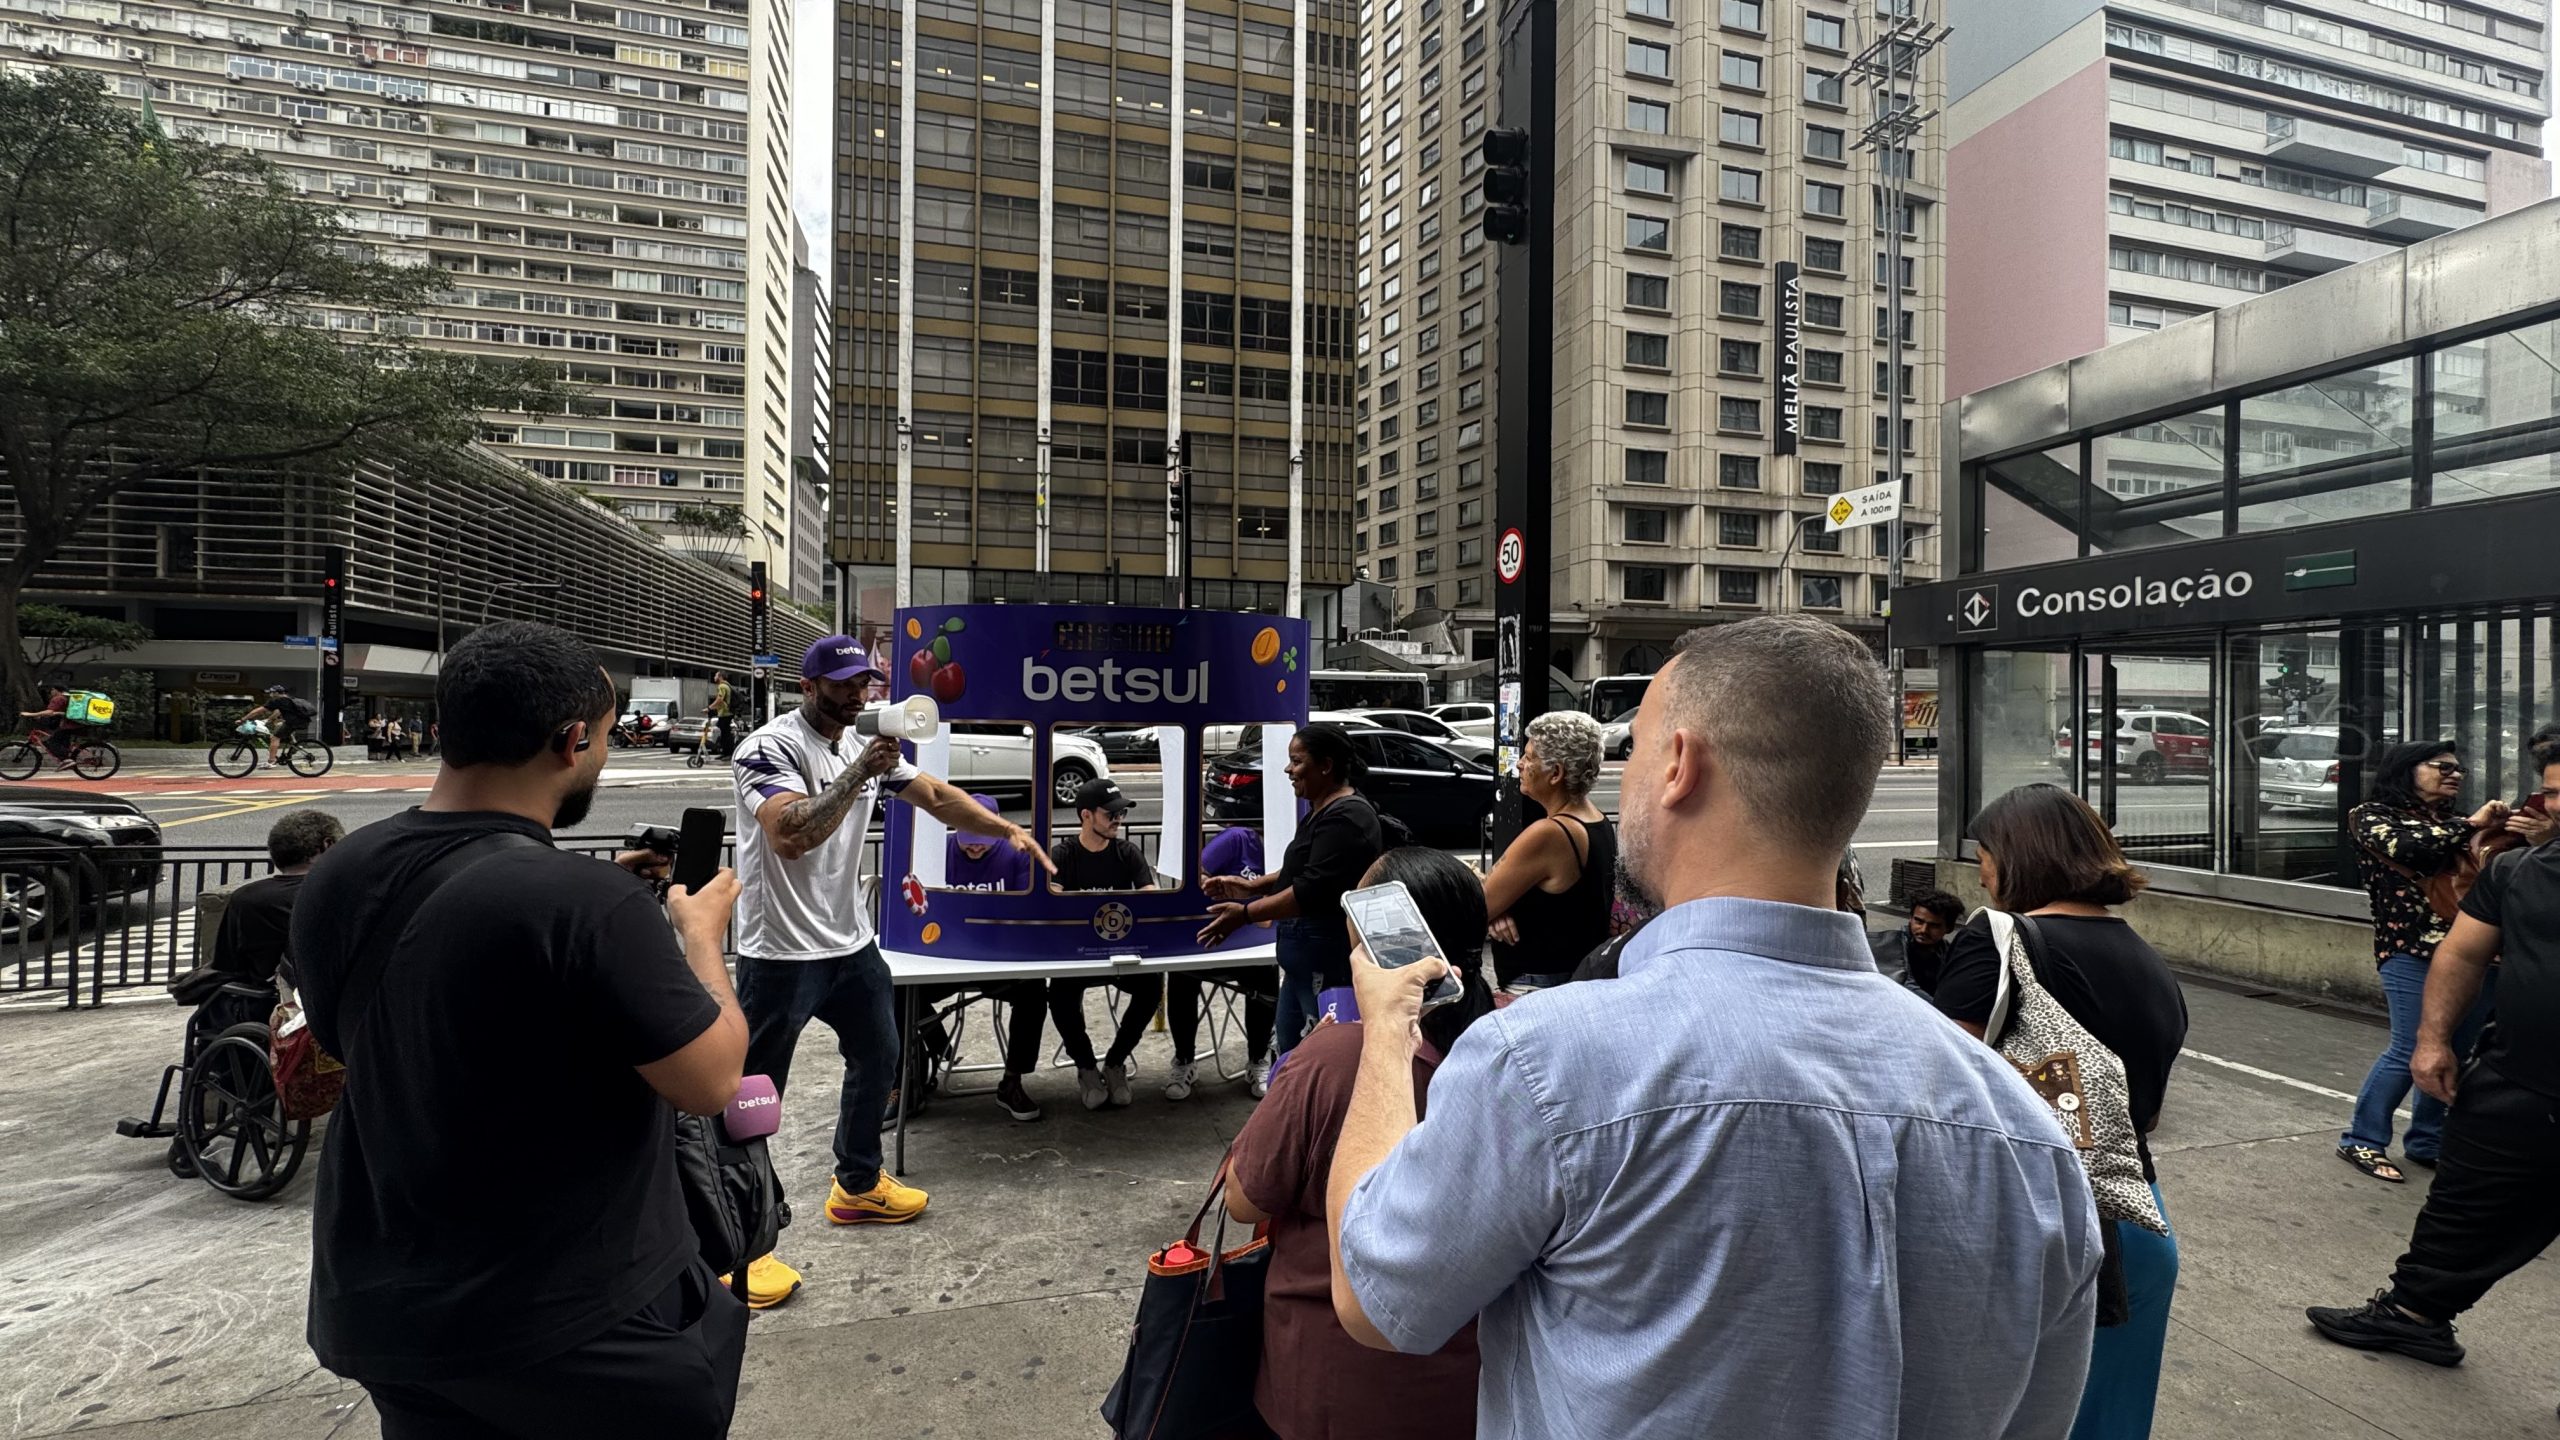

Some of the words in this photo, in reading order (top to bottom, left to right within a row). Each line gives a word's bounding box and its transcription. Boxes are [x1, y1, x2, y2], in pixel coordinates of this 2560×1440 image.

[1785, 277, 1799, 366] PAULISTA
[1862, 490, 1892, 504] SAÍDA
[1861, 508, 1868, 517] A
[1870, 505, 1892, 515] 100m
[1502, 540, 1520, 566] 50
[2016, 568, 2253, 618] Consolação
[835, 646, 866, 656] betsu
[1022, 656, 1209, 704] betsul
[738, 1094, 777, 1110] betsul
